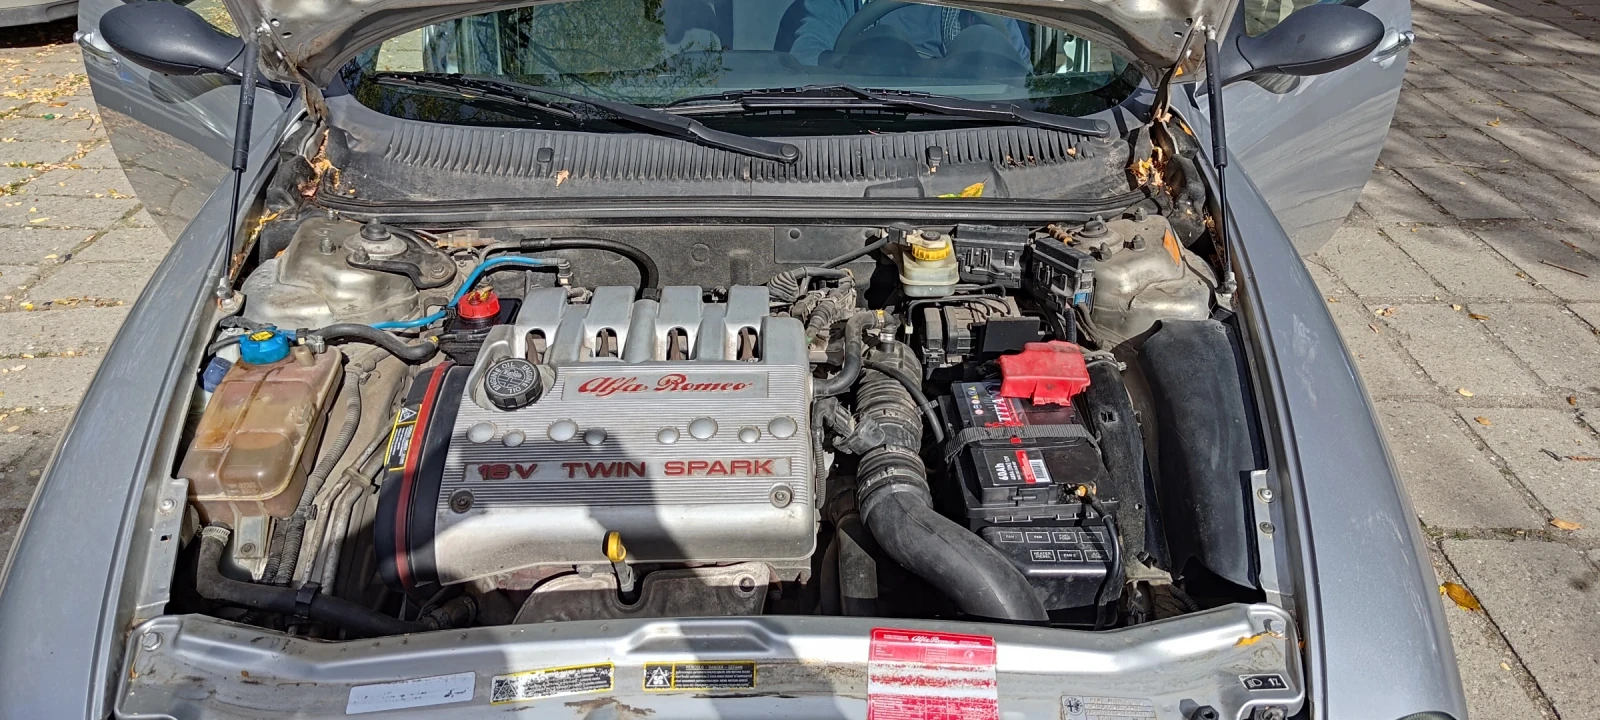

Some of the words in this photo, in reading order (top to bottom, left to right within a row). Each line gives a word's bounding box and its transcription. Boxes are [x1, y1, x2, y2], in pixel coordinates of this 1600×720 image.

[489, 367, 502, 391] ENGINE
[501, 361, 516, 369] OIL
[521, 364, 533, 388] ENGINE
[577, 376, 648, 397] Alfa
[653, 373, 753, 392] Romeo
[507, 386, 522, 394] OIL
[562, 461, 646, 479] TWIN
[663, 459, 774, 476] SPARK
[995, 462, 1009, 481] 60Ah
